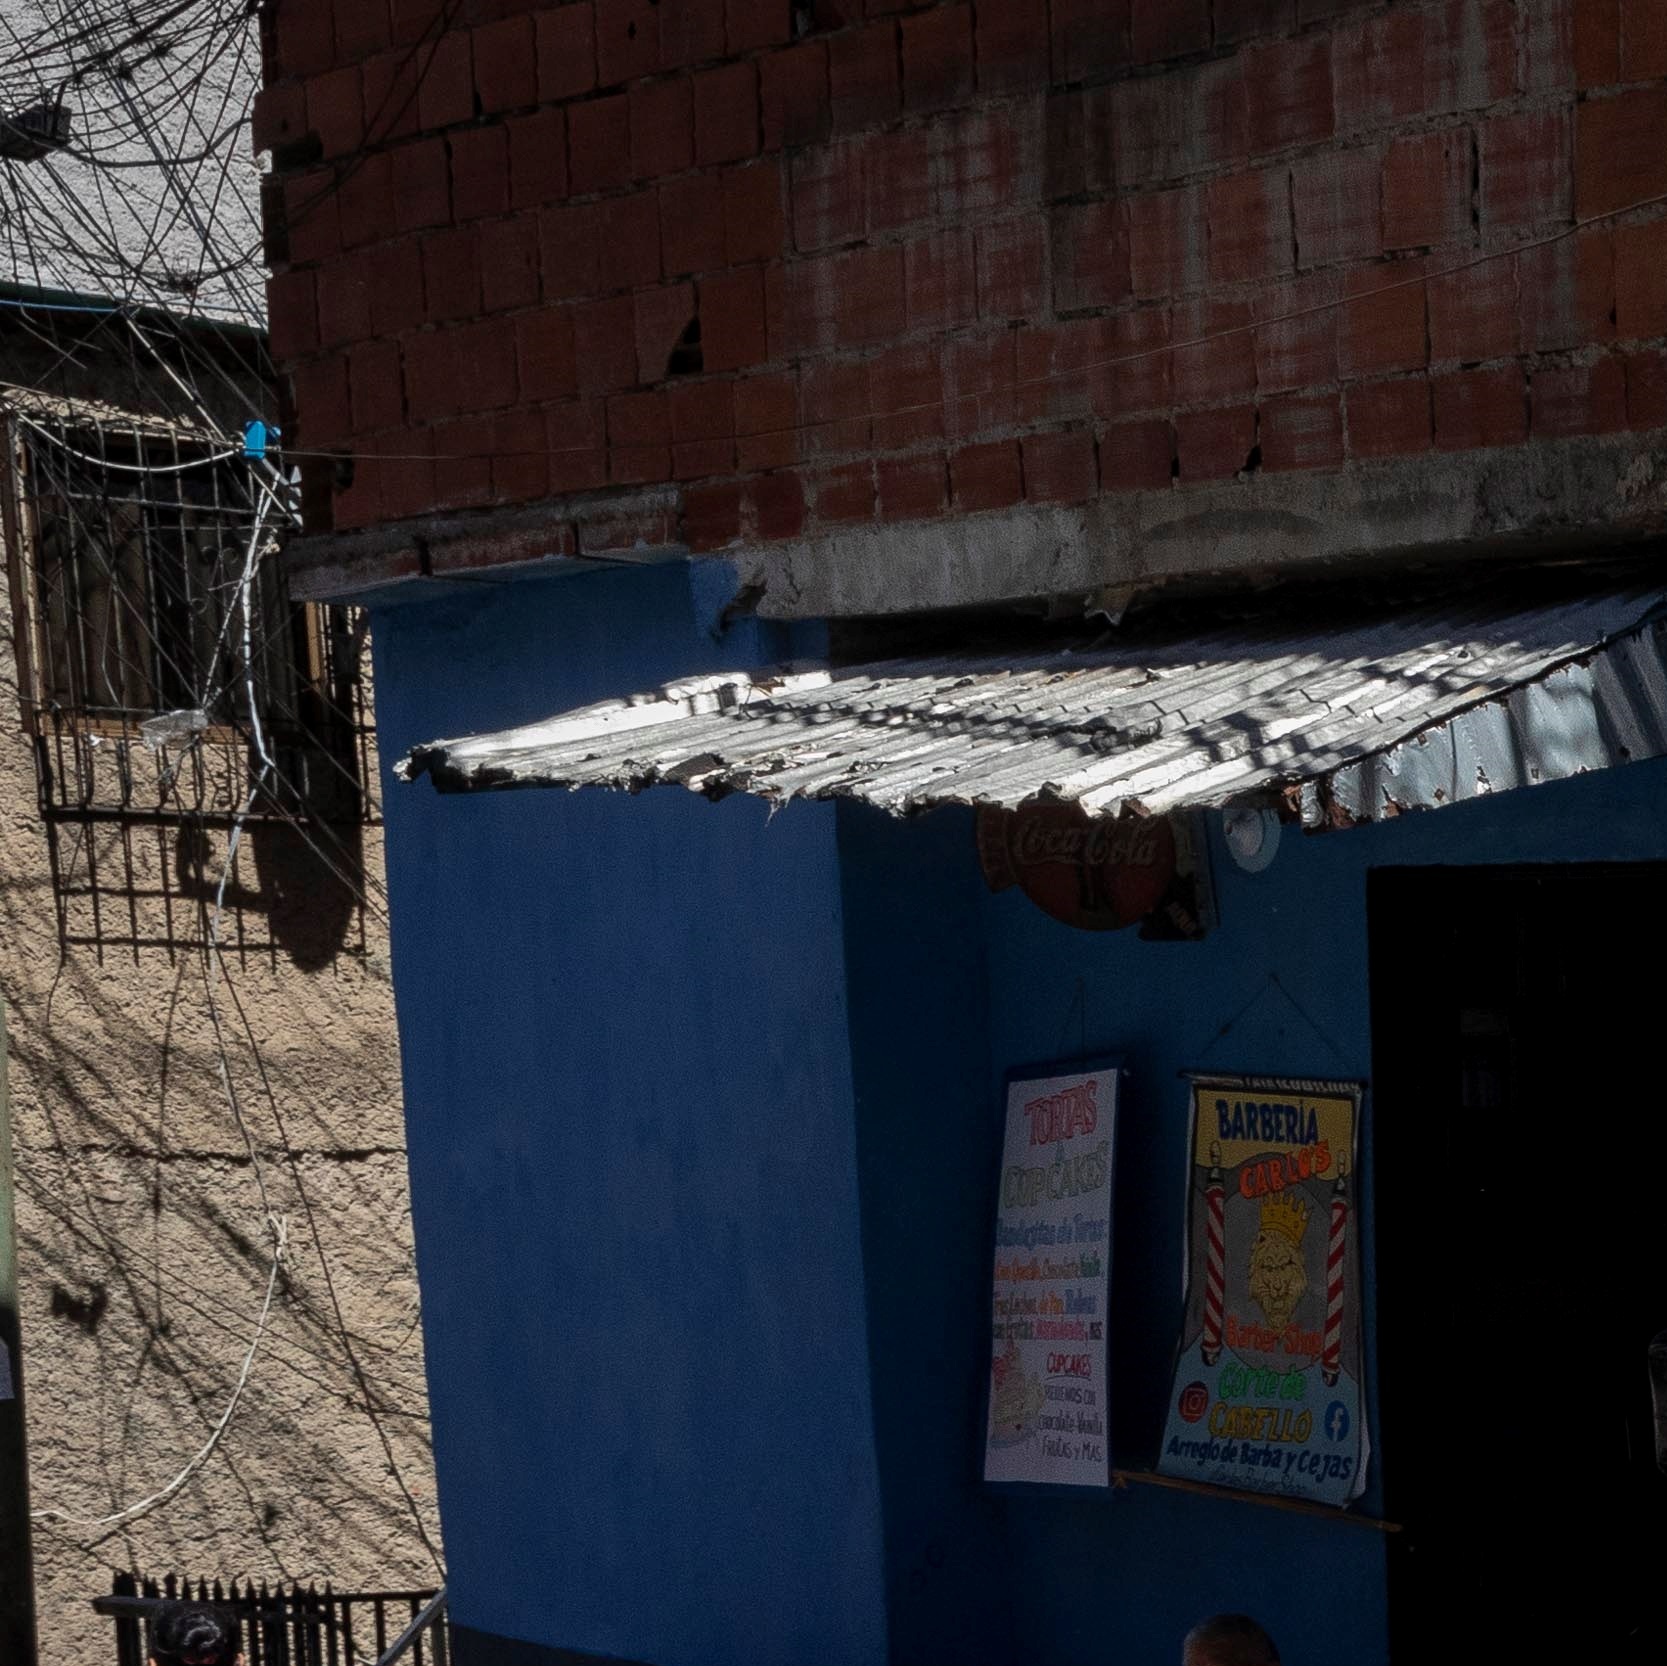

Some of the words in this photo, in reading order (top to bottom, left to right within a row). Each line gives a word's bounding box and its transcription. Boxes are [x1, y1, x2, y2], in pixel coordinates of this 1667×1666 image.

[1023, 1079, 1098, 1145] TORTAS
[1218, 1361, 1278, 1400] Corte
[1279, 1363, 1307, 1400] de
[1207, 1401, 1313, 1443] CABELLO
[1240, 1440, 1281, 1469] Barba
[1285, 1451, 1297, 1469] y
